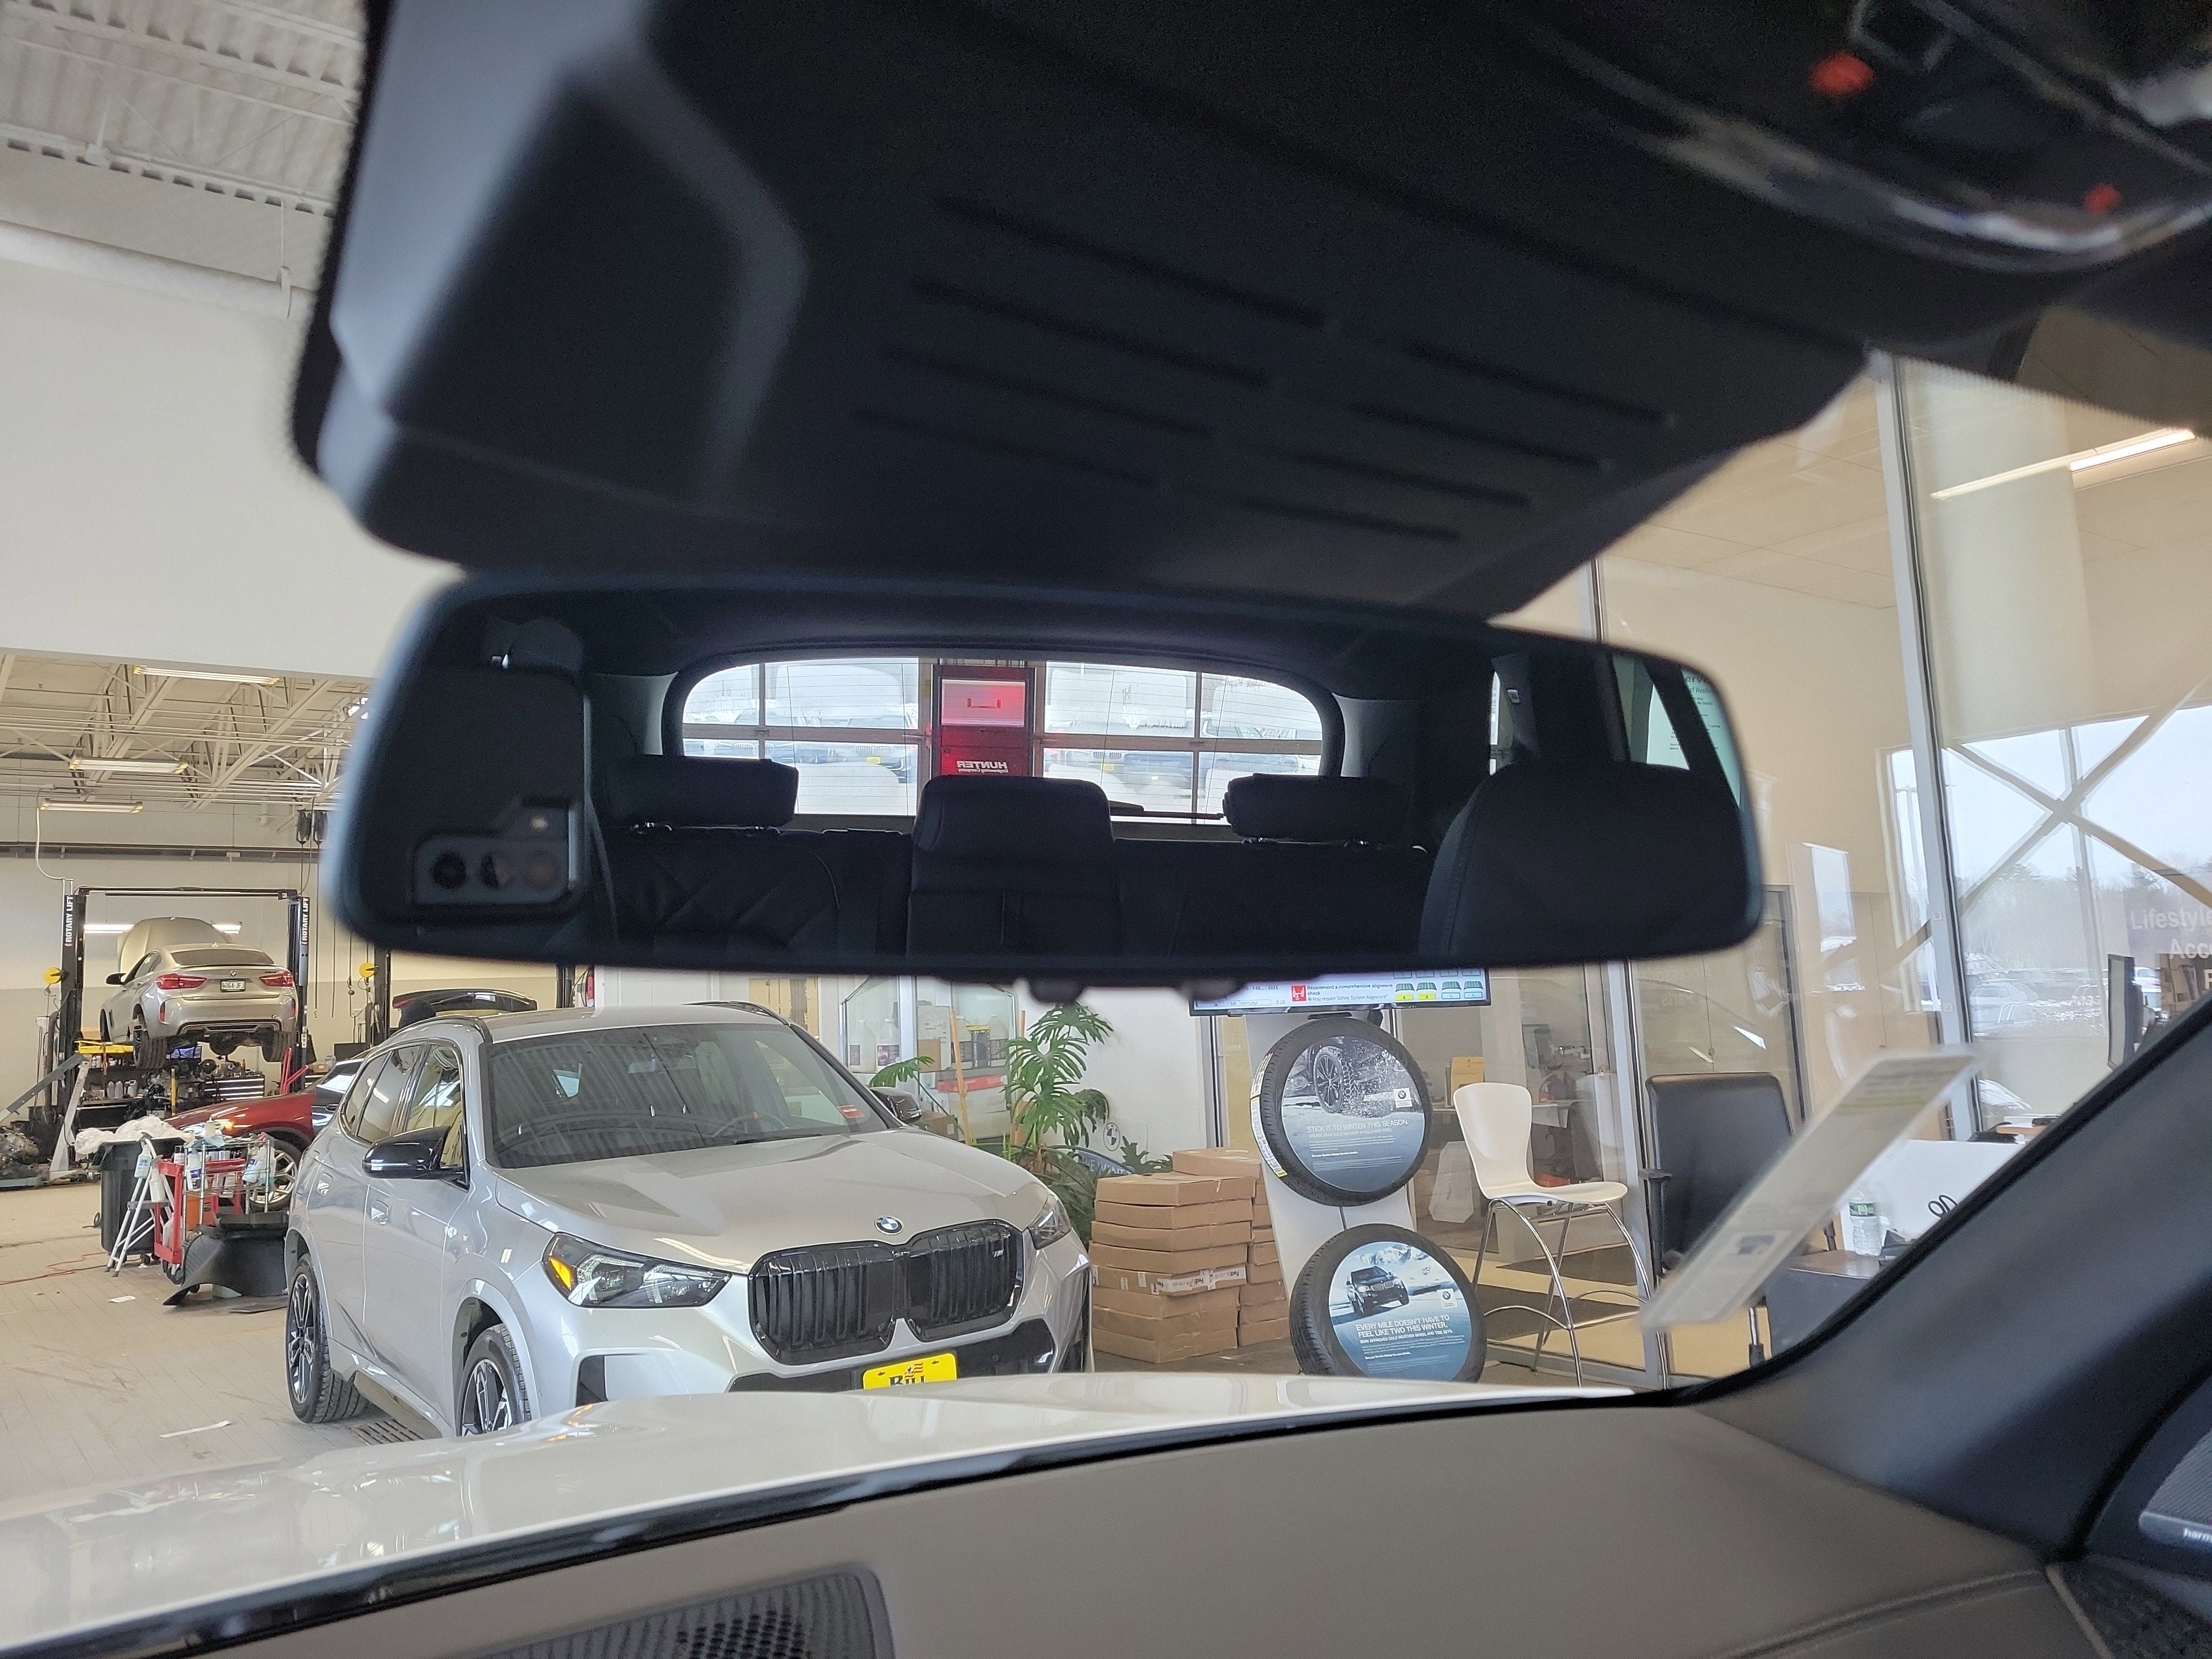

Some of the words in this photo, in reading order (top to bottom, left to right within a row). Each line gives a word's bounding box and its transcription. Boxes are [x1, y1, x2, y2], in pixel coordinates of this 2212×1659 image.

[2169, 939, 2212, 959] Acc
[1382, 1119, 1409, 1127] SEASON.
[1356, 1323, 1377, 1331] EVERY
[1378, 1321, 1394, 1329] MILE
[1394, 1318, 1421, 1327] DOESN'T
[1358, 1330, 1375, 1338] FEEL
[1407, 1324, 1421, 1333] THIS
[1421, 1322, 1448, 1330] WINTER.
